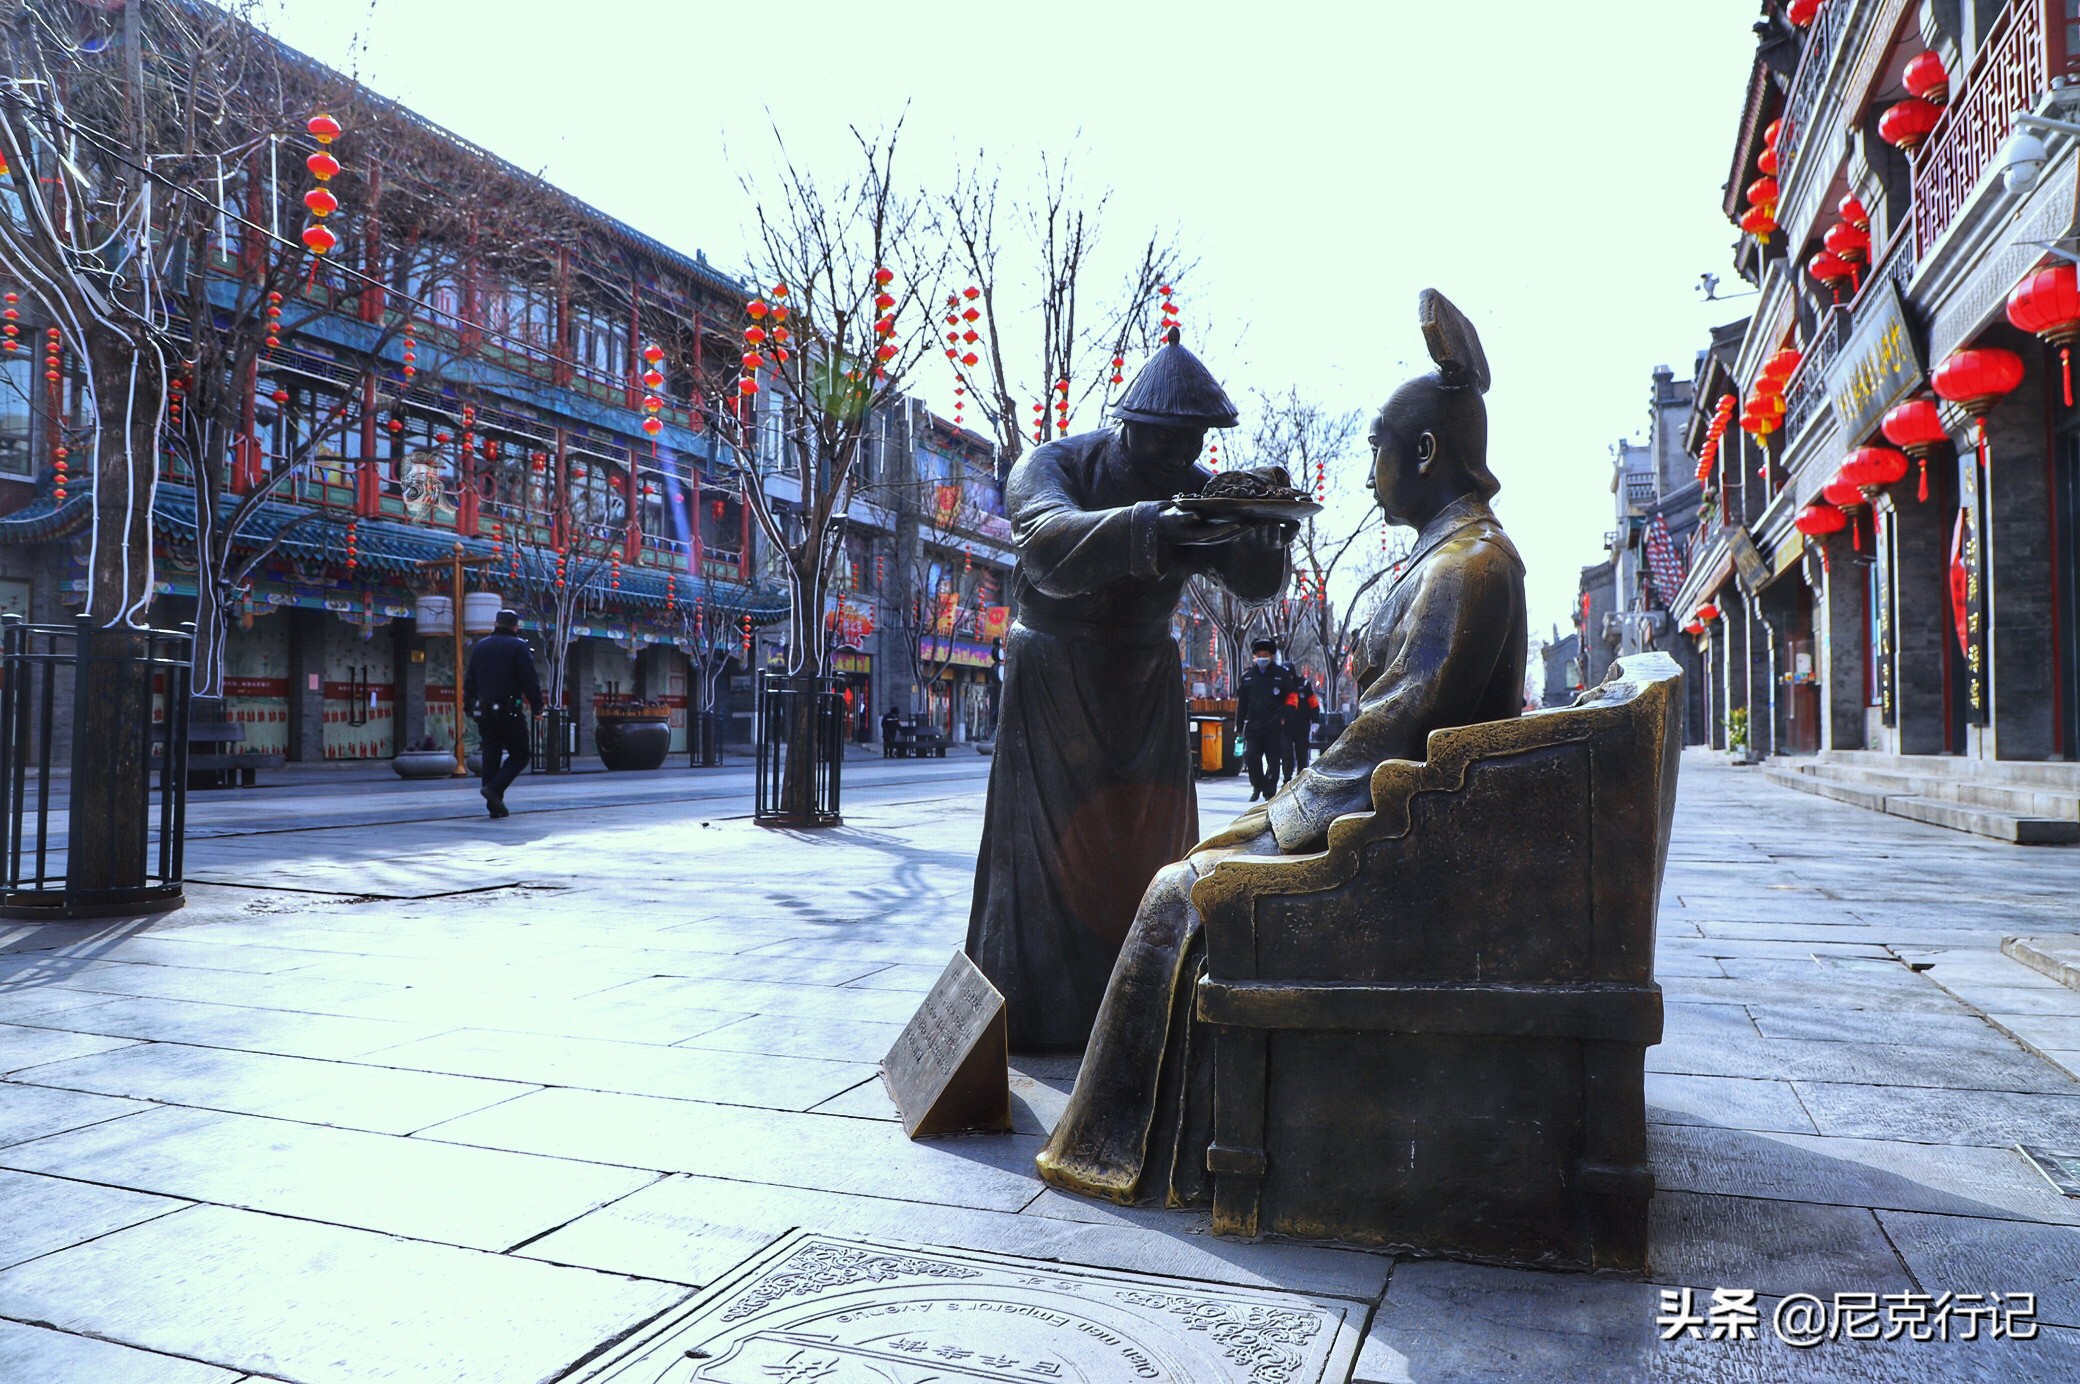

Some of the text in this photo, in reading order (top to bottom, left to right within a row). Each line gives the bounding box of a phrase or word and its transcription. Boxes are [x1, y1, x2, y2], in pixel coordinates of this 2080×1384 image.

[836, 1301, 1160, 1379] Qian men Emperor's Avenue
